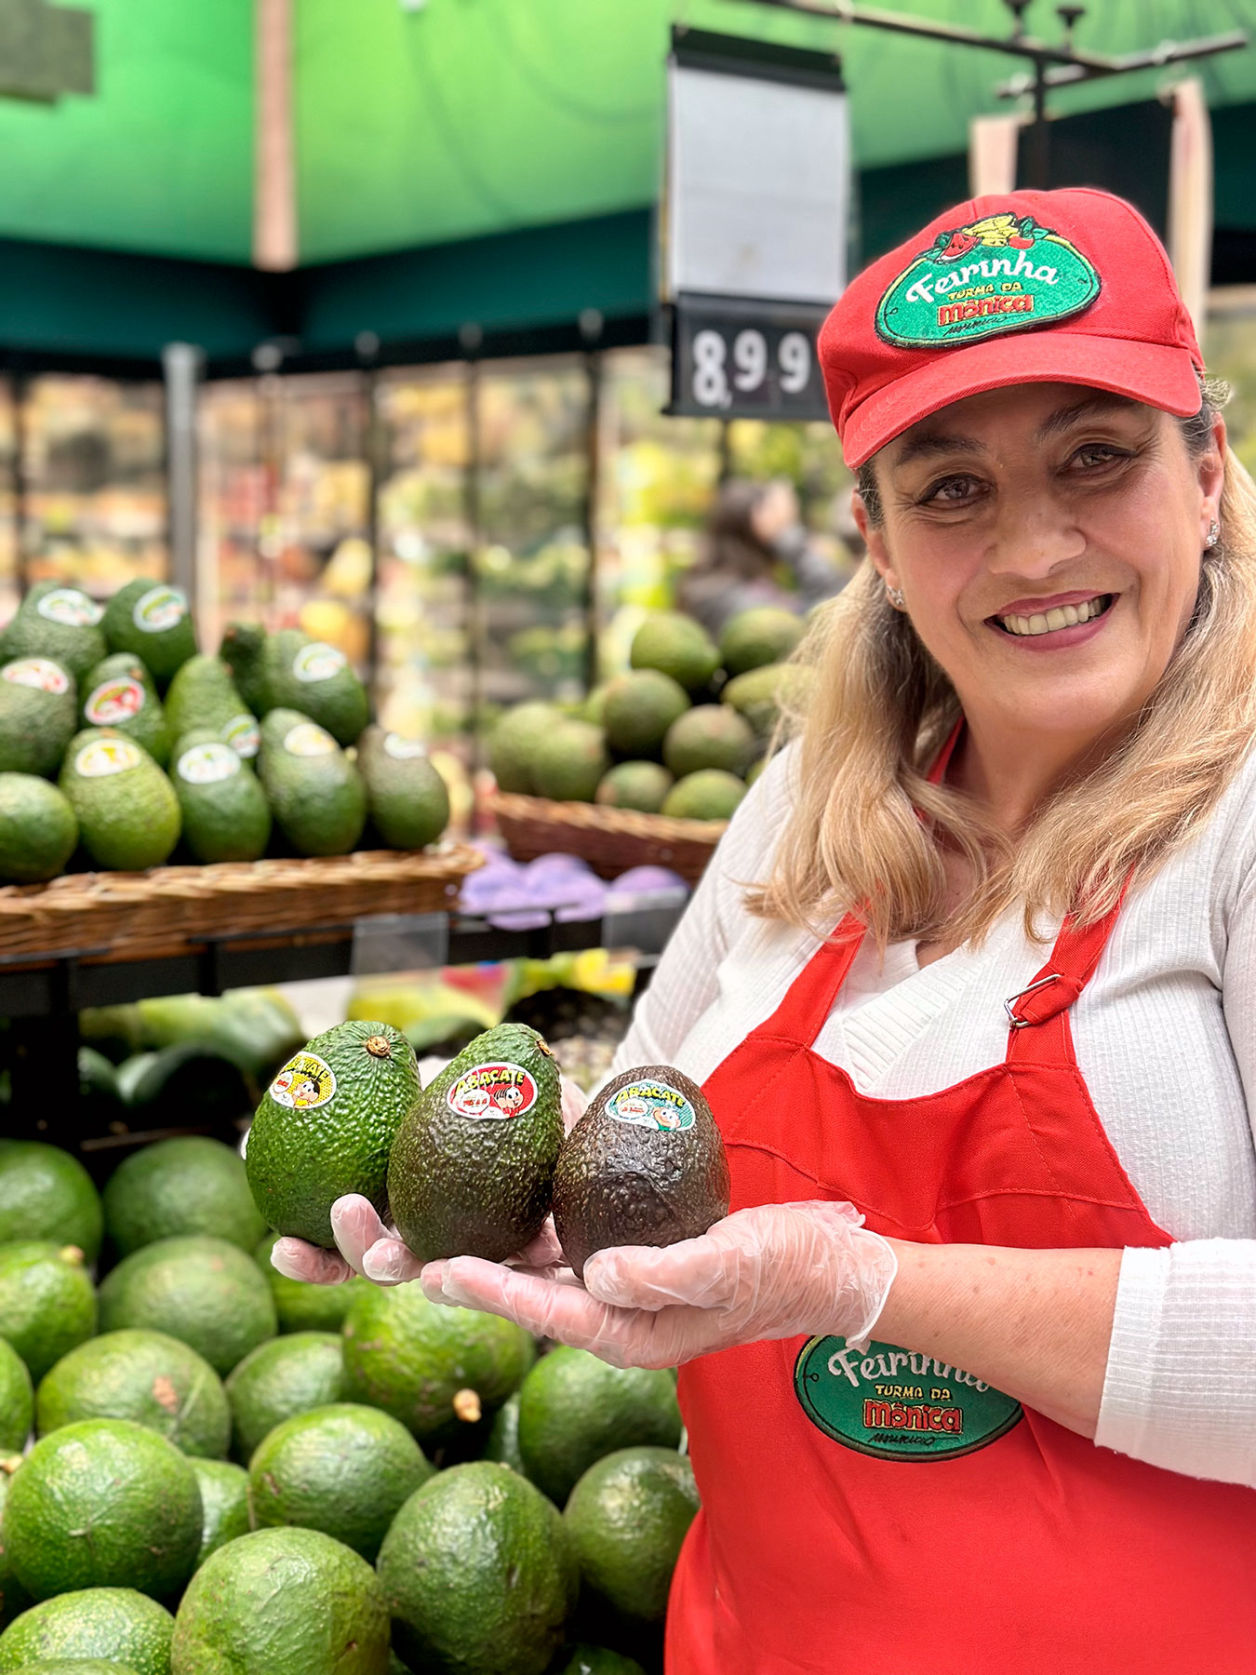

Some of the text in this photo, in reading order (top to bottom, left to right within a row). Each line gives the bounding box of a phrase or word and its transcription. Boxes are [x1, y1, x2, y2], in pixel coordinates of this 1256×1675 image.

[905, 251, 1059, 303] Feirinha
[947, 281, 1023, 301] TURMA DA
[453, 1068, 525, 1098] ABACATE
[614, 1086, 686, 1108] ABACATE
[874, 1384, 953, 1402] TURMA DA
